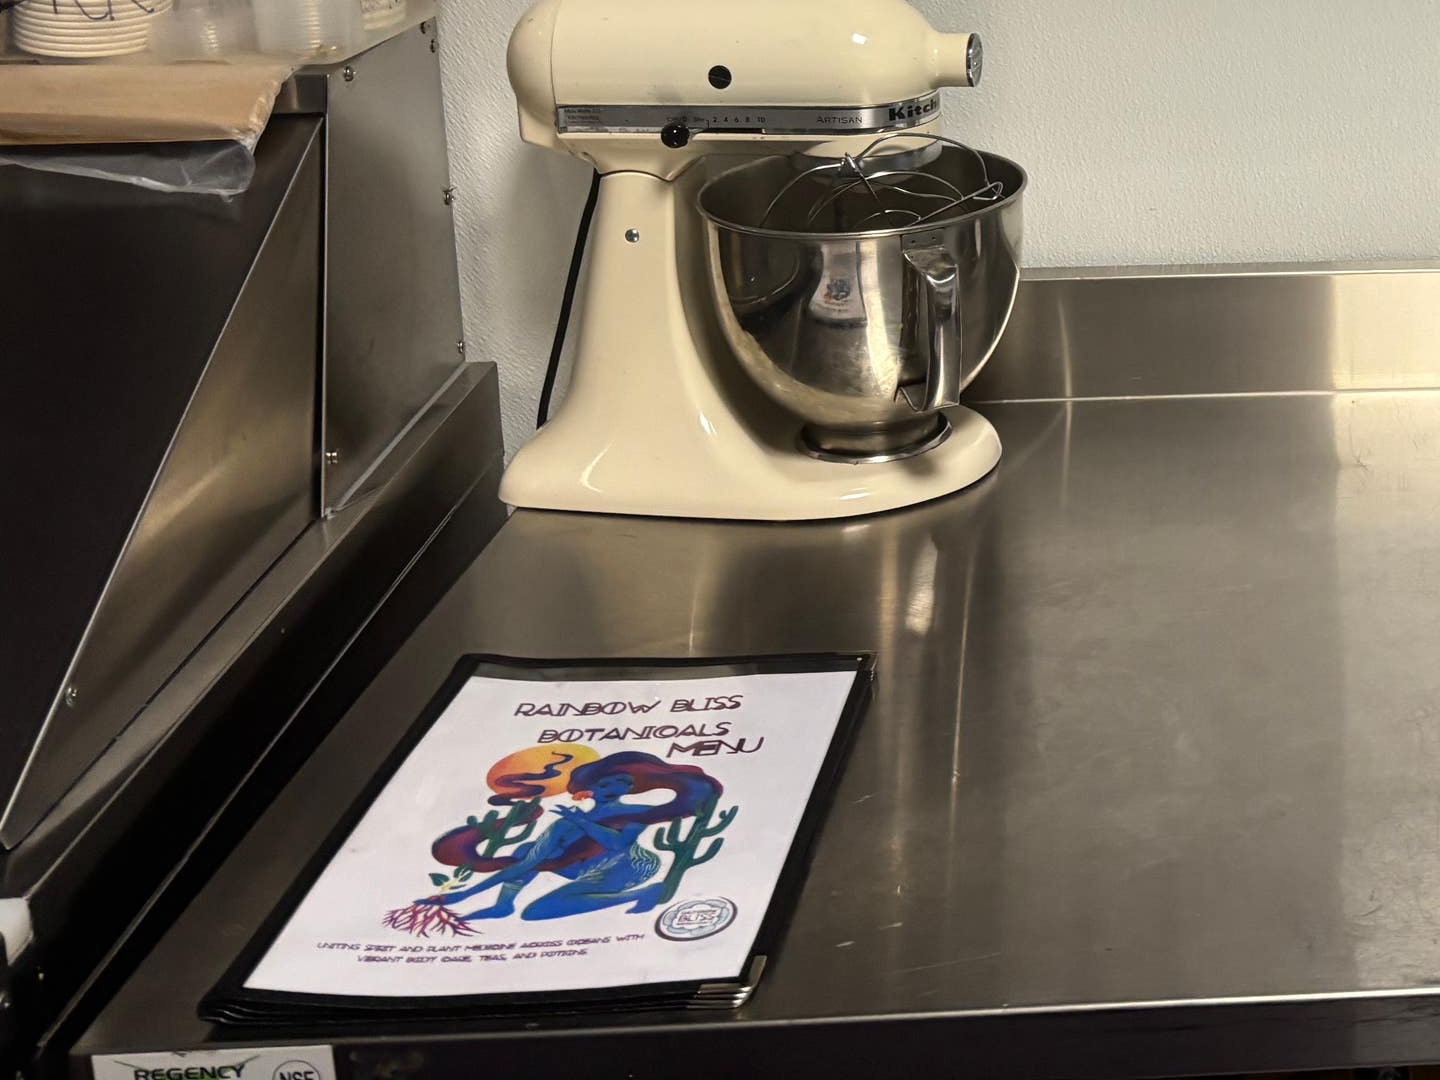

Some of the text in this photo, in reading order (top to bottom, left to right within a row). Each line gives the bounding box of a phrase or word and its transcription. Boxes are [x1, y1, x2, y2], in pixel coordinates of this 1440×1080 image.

[816, 115, 863, 124] ARTISAN
[513, 695, 744, 717] RAINBOW BLISS
[537, 721, 732, 744] BOTANICALS
[666, 737, 765, 758] MENU
[317, 942, 361, 951] UNITING
[427, 944, 462, 952] PLANT
[616, 933, 645, 943] WITH
[513, 951, 537, 959] AND
[134, 1065, 246, 1080] REGENCY
